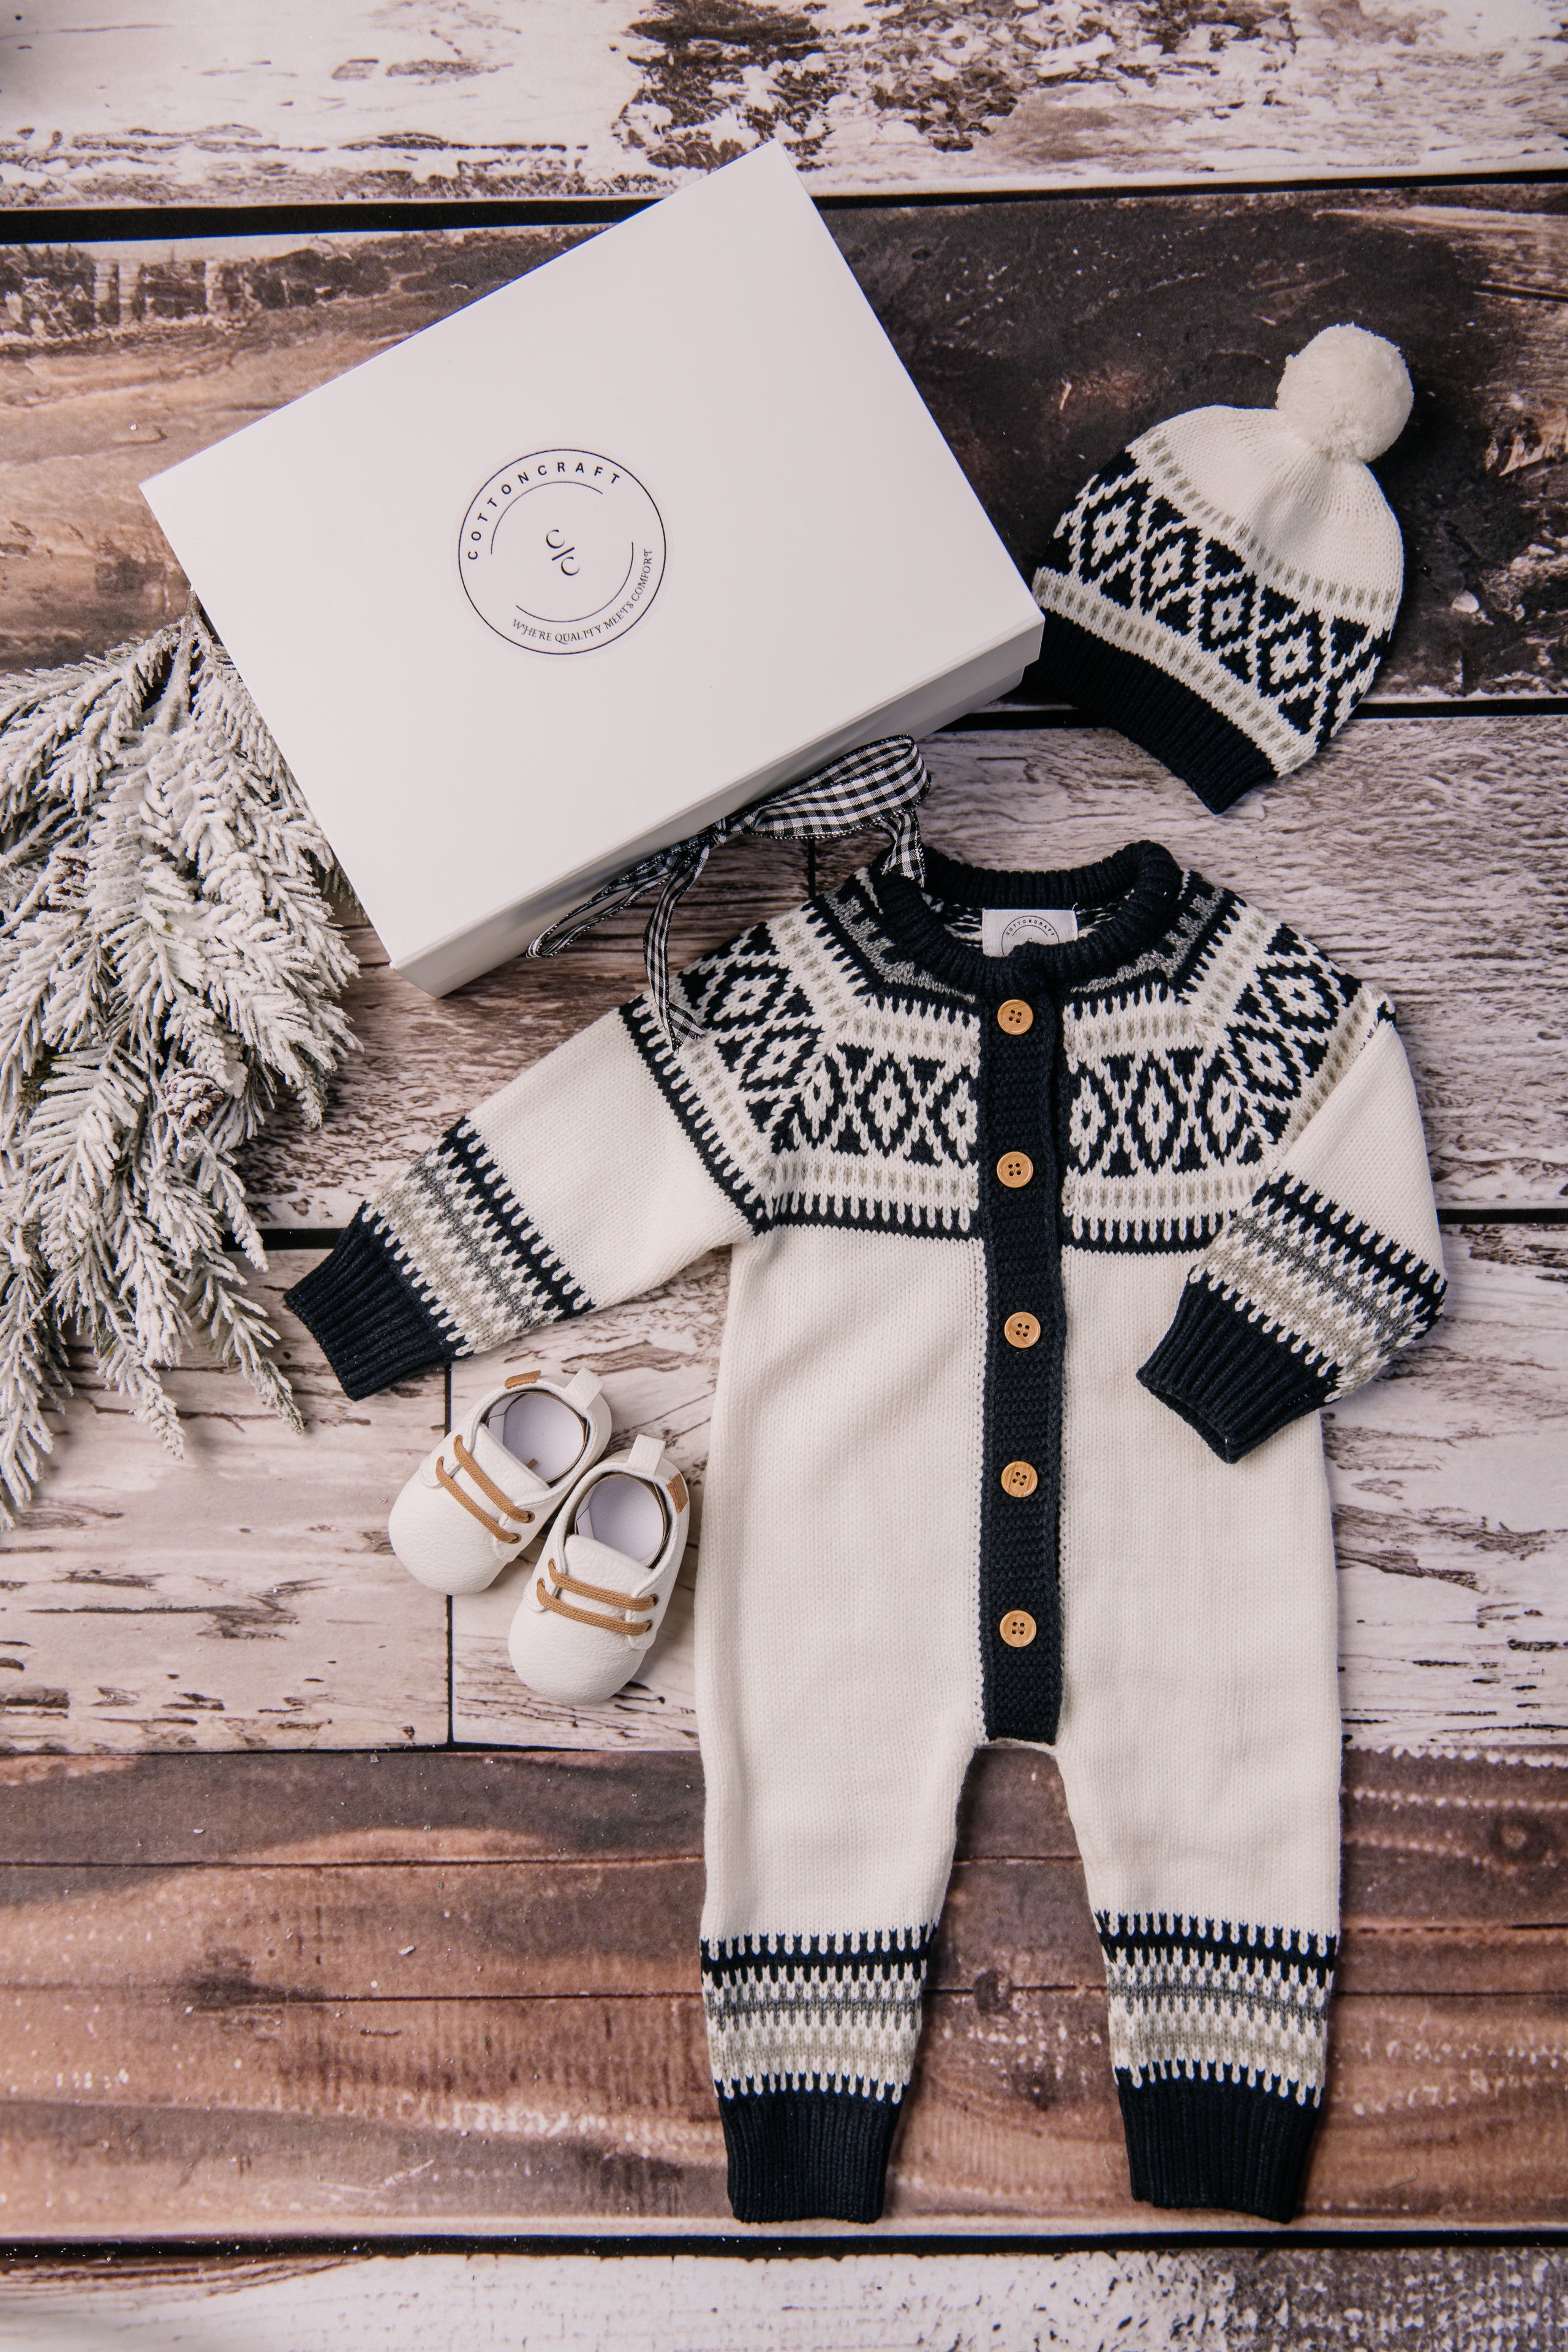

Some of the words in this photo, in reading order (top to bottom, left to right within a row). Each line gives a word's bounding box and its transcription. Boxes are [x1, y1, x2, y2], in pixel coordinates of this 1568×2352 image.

[467, 462, 620, 560] COTTONCRAFT
[513, 619, 552, 641] WHERE
[555, 625, 602, 645] QUALITY
[603, 601, 635, 630] MEETS
[631, 548, 653, 602] COMFORT
[1006, 919, 1055, 936] COTTONCRAFT
